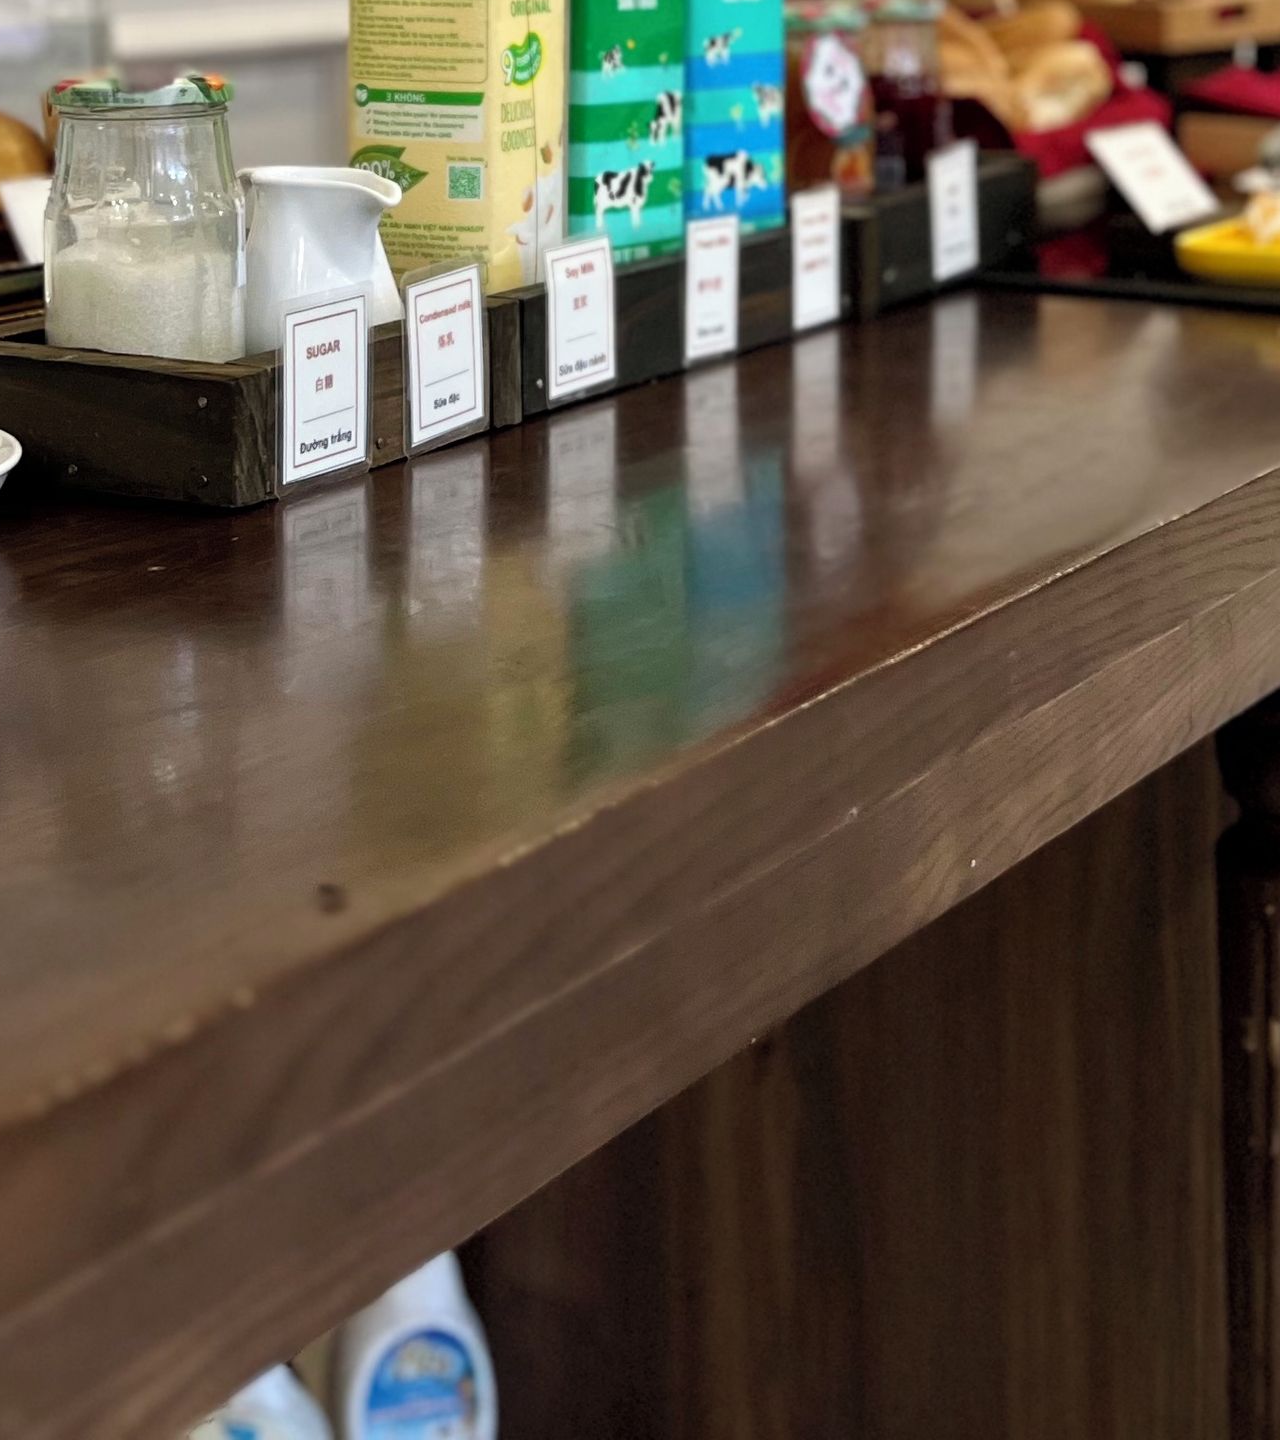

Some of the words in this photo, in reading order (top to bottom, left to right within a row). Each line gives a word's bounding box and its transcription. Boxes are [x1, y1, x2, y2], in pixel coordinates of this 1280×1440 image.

[386, 92, 392, 101] 3
[565, 267, 579, 279] Soy
[580, 261, 595, 274] Milk
[419, 303, 458, 324] Condensed
[306, 339, 341, 360] SUGAR
[299, 438, 329, 455] Đường
[330, 428, 352, 445] trắng
